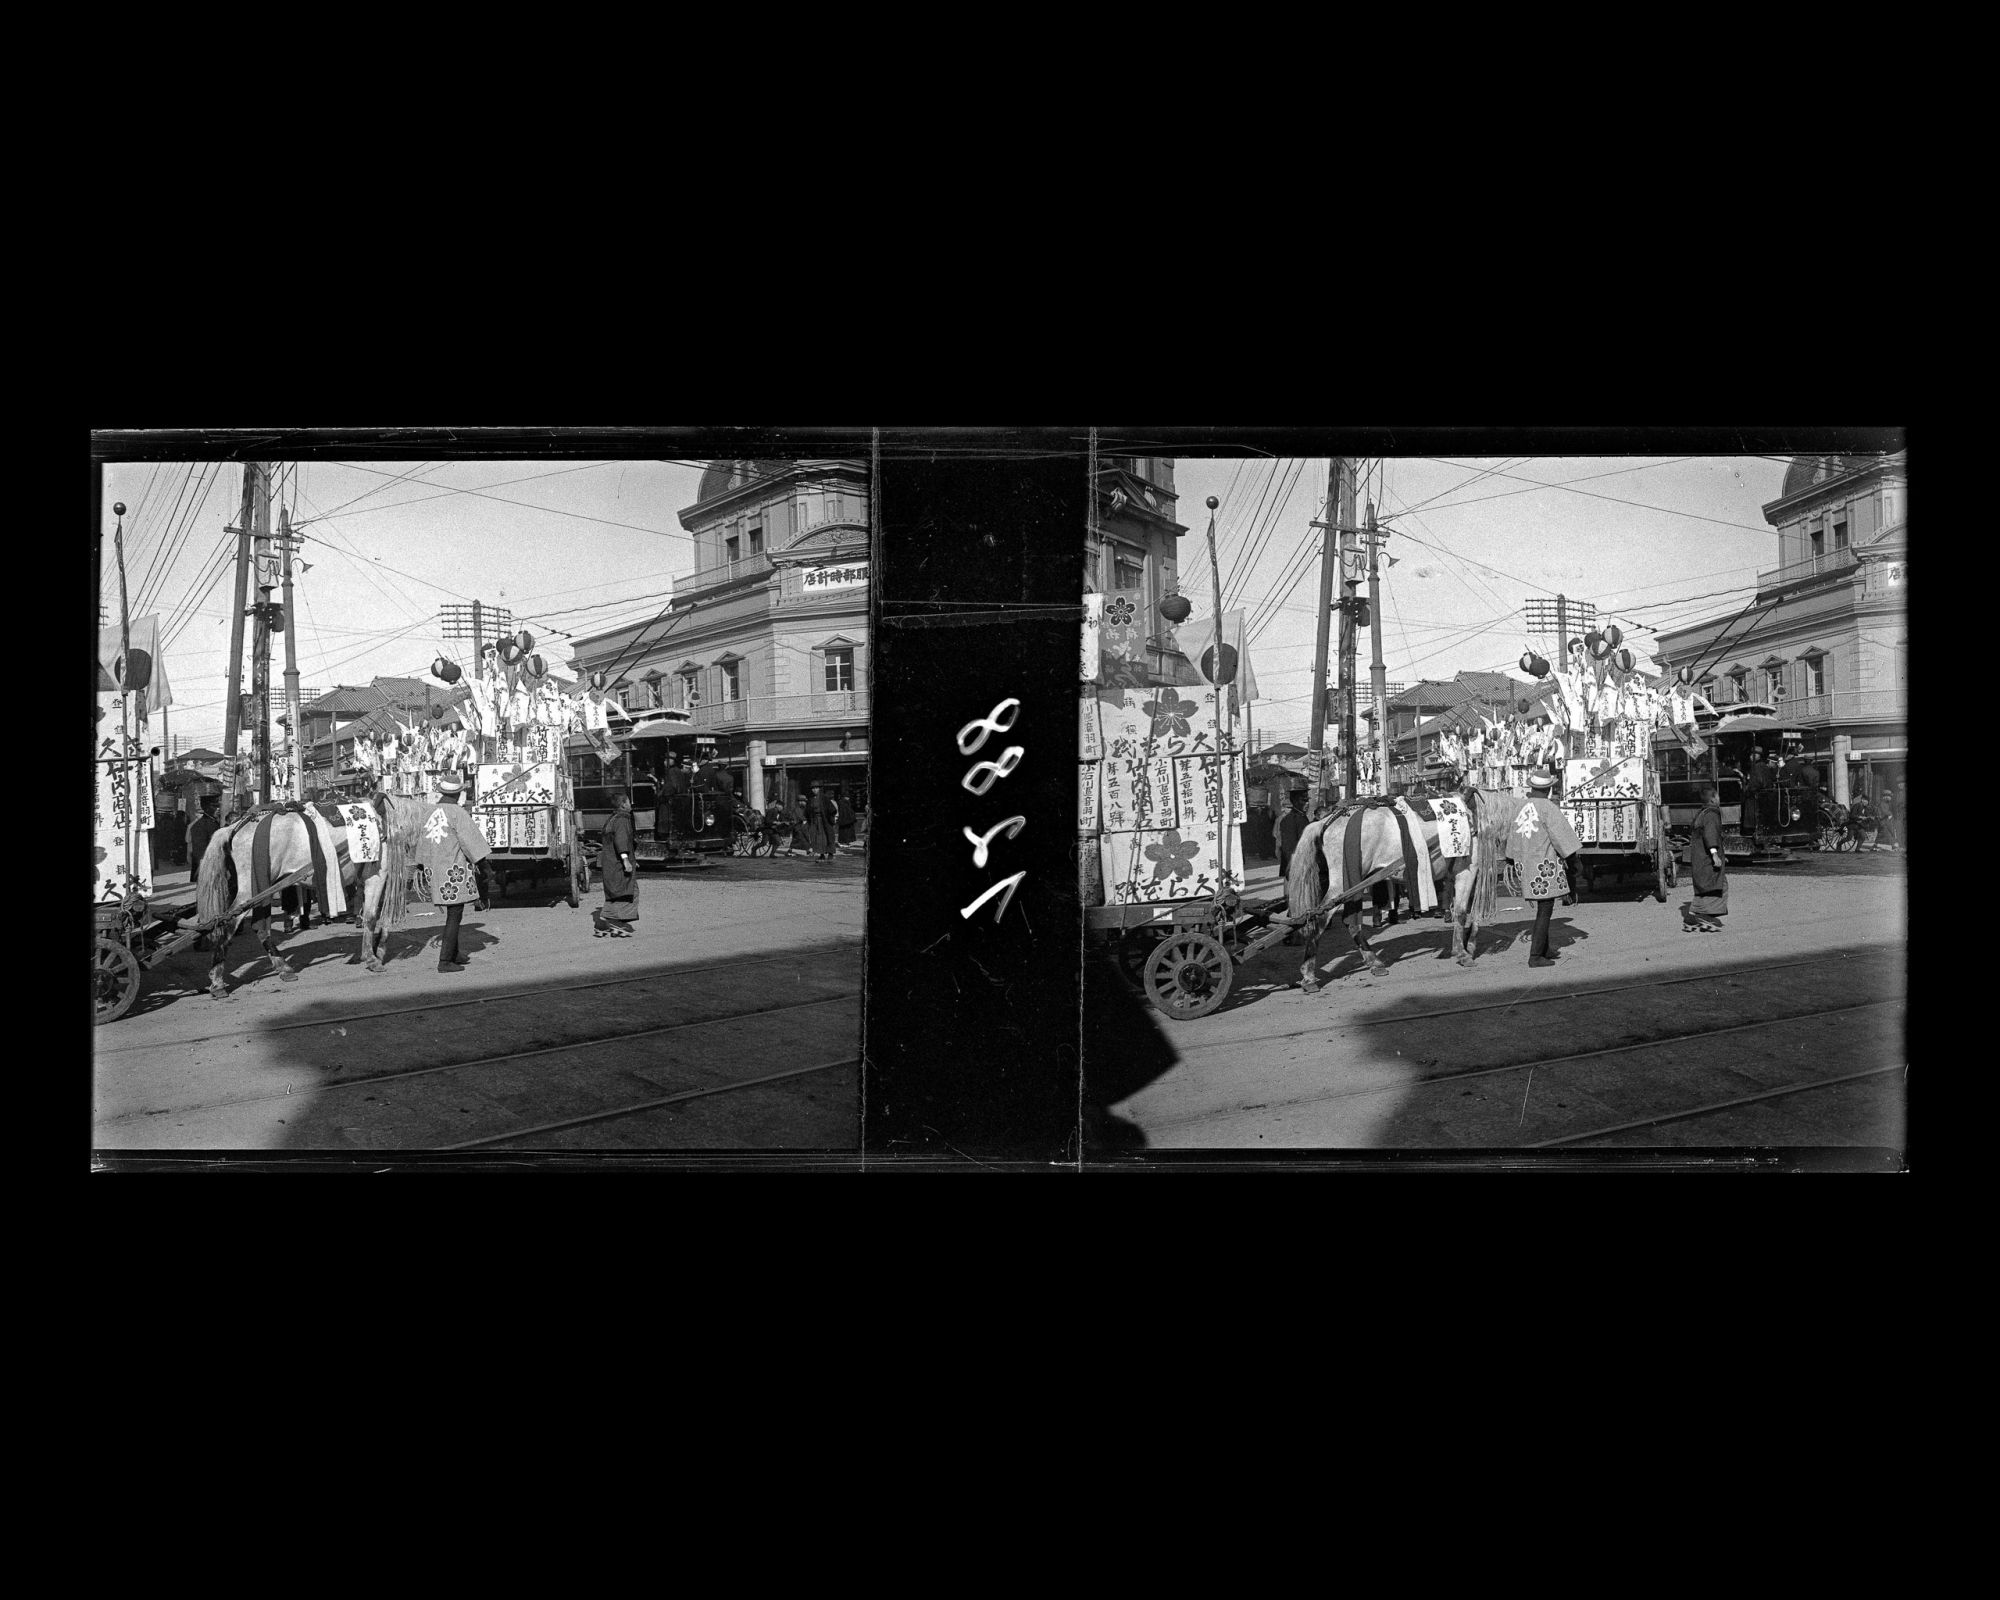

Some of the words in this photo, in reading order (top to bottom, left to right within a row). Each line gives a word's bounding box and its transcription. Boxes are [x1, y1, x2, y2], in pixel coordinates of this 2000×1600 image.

[804, 567, 869, 586] 服部時計店
